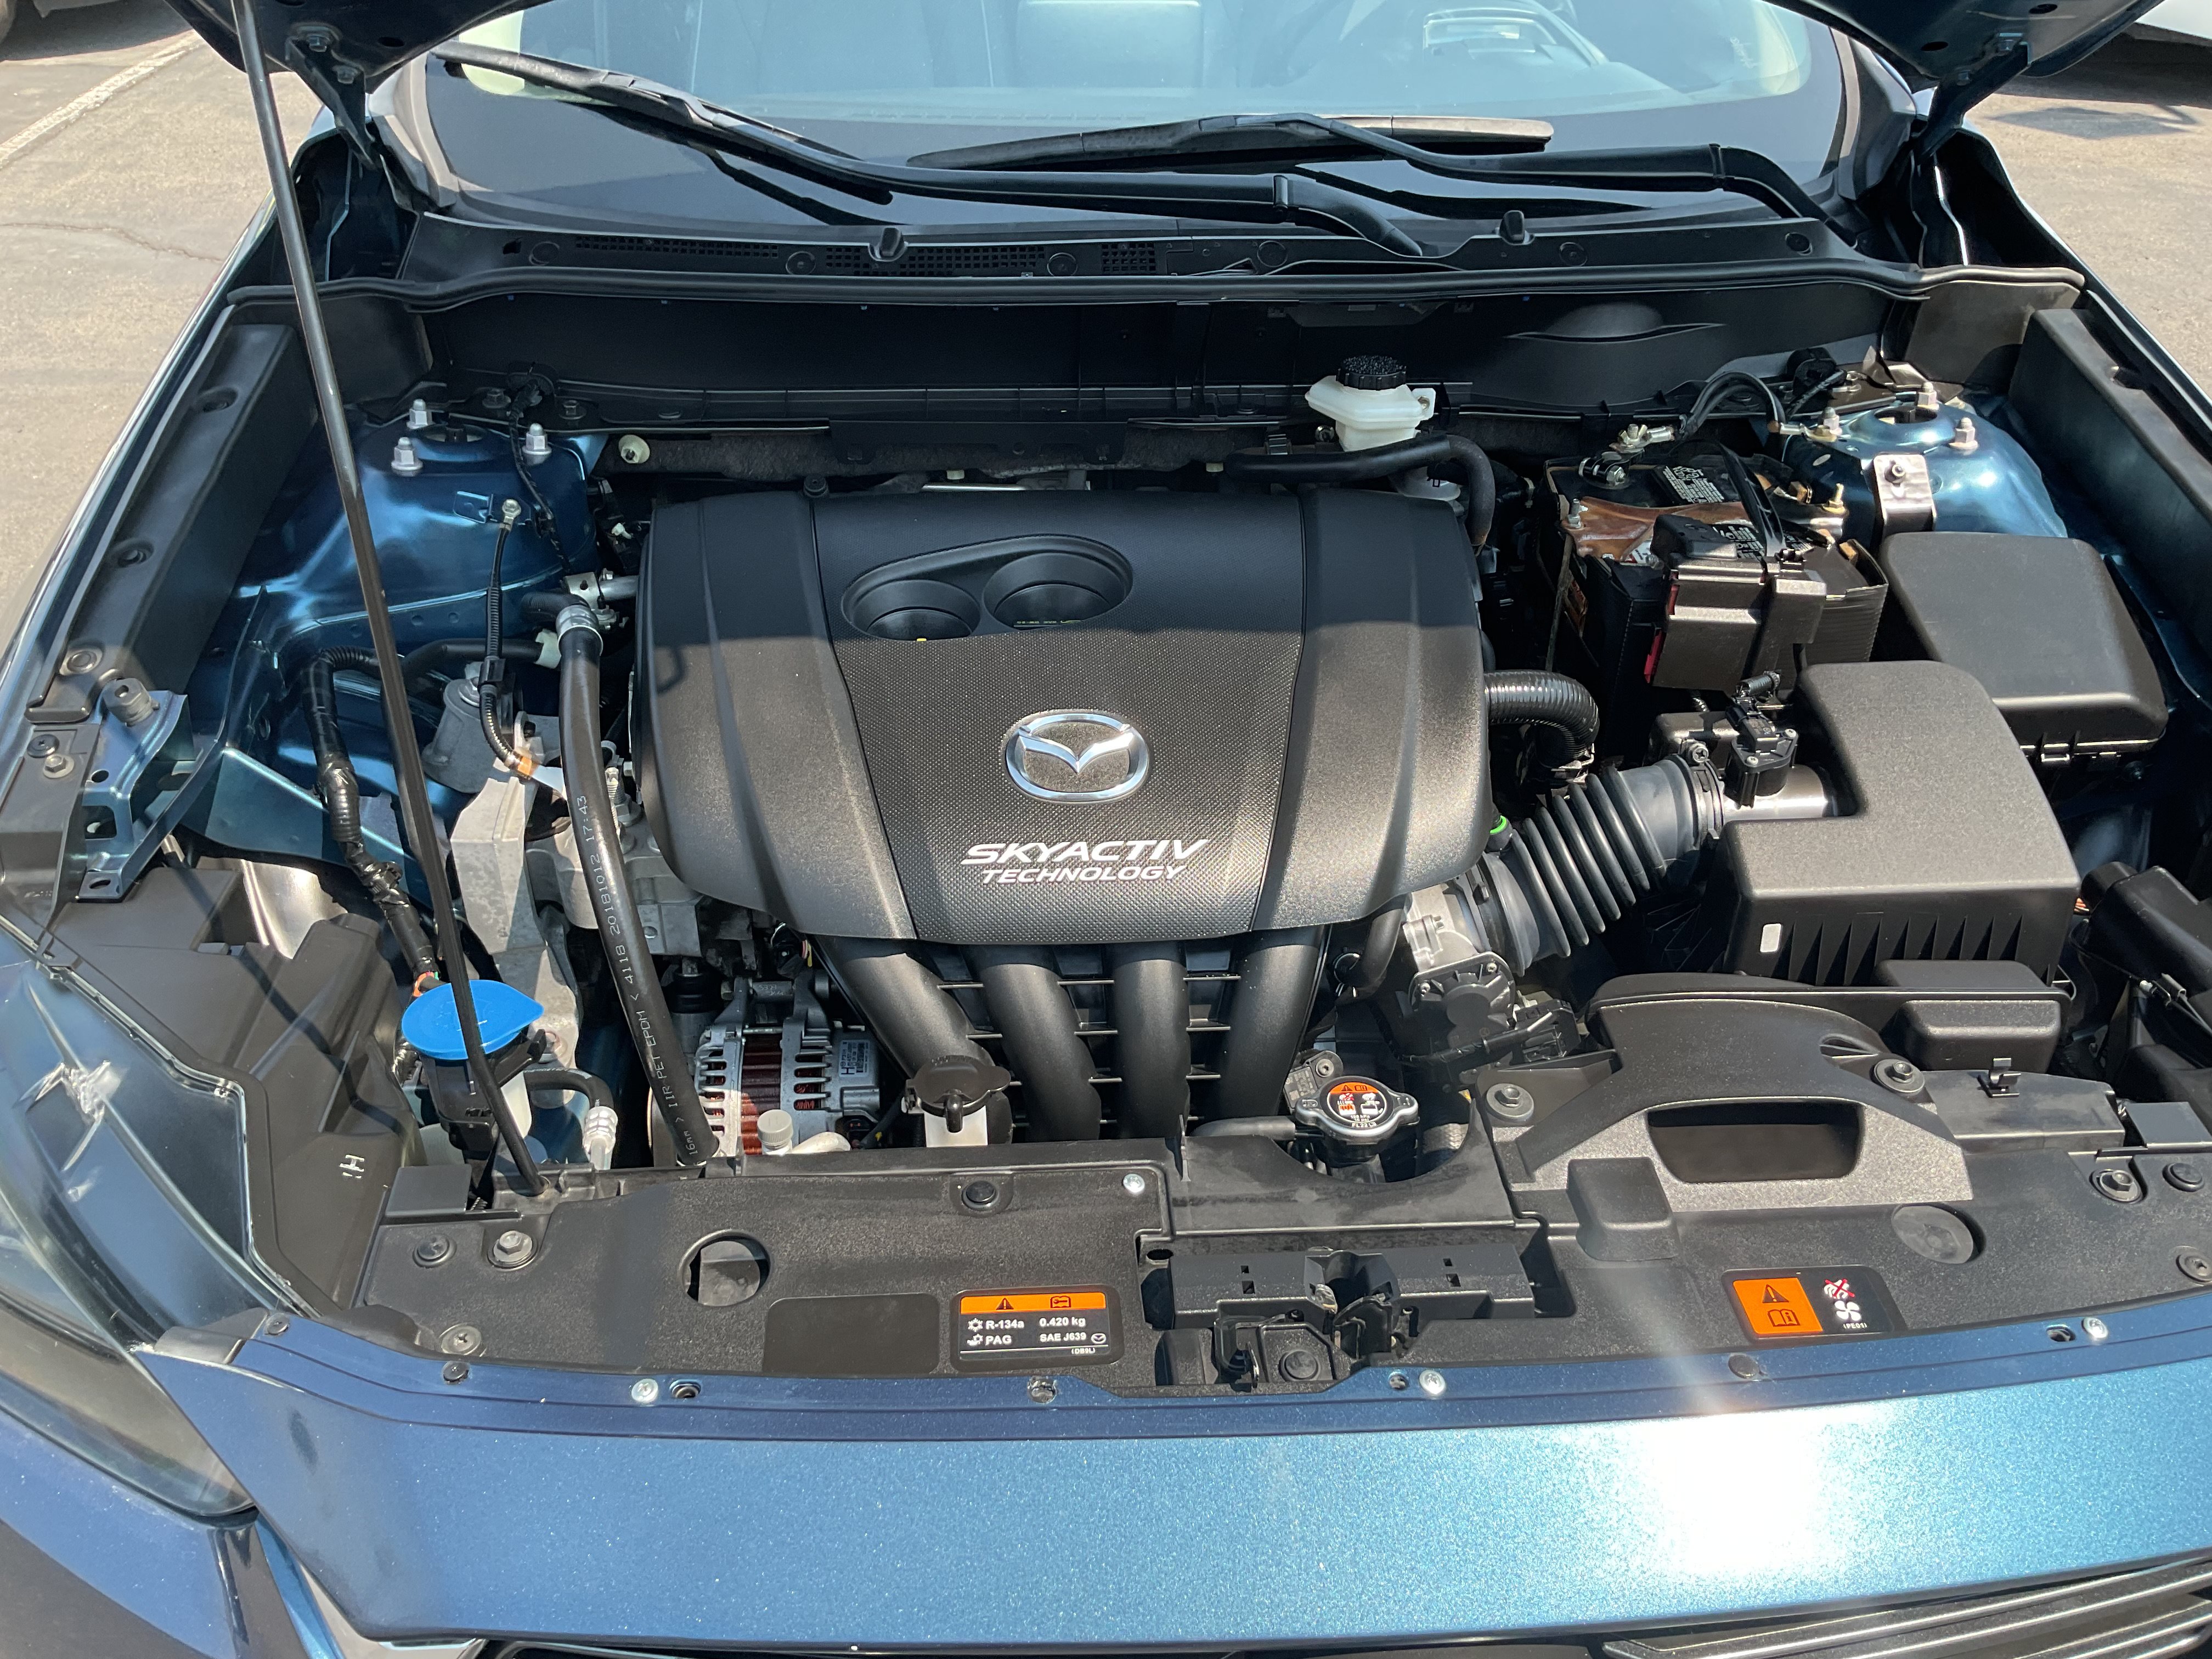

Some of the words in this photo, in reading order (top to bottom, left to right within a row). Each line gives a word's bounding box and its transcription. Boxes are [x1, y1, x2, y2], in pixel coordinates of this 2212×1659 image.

[577, 795, 594, 842] 17:43
[961, 839, 1209, 865] SKYACTIV
[983, 865, 1188, 884] TECHNOLOGY
[590, 853, 620, 936] 20181012
[616, 945, 634, 984] 4118
[636, 1010, 656, 1046] EPDM
[651, 1054, 667, 1079] PET
[985, 1319, 1025, 1330] R-134a
[1039, 1317, 1069, 1327] 0.420
[1071, 1317, 1086, 1328] kg
[985, 1335, 1012, 1345] PAG
[1040, 1333, 1062, 1342] SAE
[1063, 1332, 1087, 1341] J639
